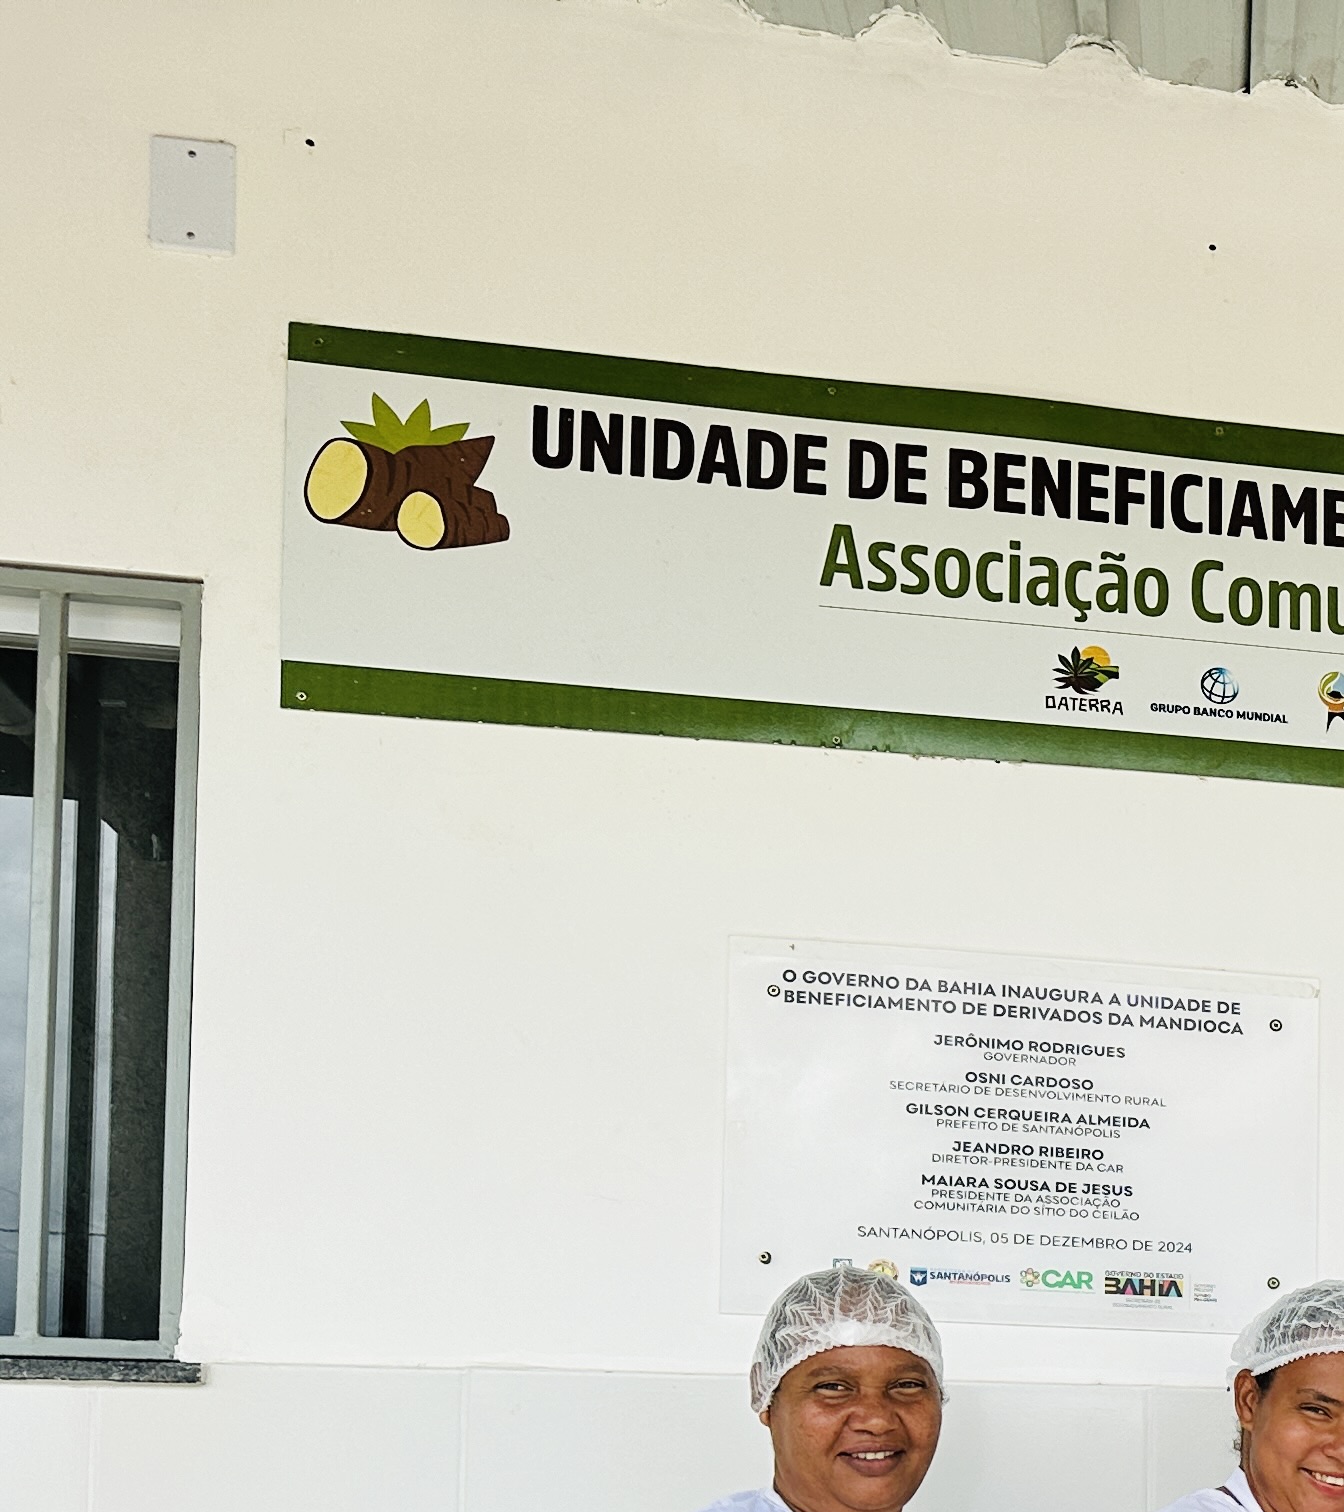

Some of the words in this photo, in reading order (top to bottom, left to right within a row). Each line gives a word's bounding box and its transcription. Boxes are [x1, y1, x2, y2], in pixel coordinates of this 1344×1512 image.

[532, 404, 827, 496] UNIDADE
[848, 438, 928, 505] DE
[819, 523, 1170, 623] Associação
[1150, 702, 1191, 716] GRUPO
[1193, 706, 1234, 720] BANCO
[1236, 711, 1289, 724] MUNDIAL
[782, 969, 797, 983] O
[802, 970, 900, 990] GOVERNO
[905, 977, 933, 993] DA
[938, 979, 997, 997] BAHIA
[1001, 984, 1104, 1005] INAUGURA
[1108, 993, 1122, 1007] A
[1126, 993, 1212, 1013] UNIDADE
[1217, 1001, 1241, 1015] DE
[784, 989, 957, 1014] BENEFICIAMENTO
[962, 1001, 988, 1016] DE
[993, 1004, 1103, 1025] DERIVADOS
[1108, 1012, 1135, 1028] DA
[1139, 1015, 1244, 1035] MANDIOCA
[933, 1032, 1024, 1052] JERÔNIMO
[1028, 1040, 1126, 1059] RODRIGUES
[983, 1051, 1077, 1067] GOVERNADOR
[964, 1071, 1006, 1085] OSNI
[1010, 1074, 1094, 1091] CARDOSO
[889, 1079, 971, 1095] SECRETÁRIO
[974, 1085, 991, 1096] DE
[995, 1086, 1122, 1105] DESENVOLVIMENTO
[1124, 1095, 1168, 1108] RURAL
[905, 1102, 969, 1117] GILSON
[973, 1106, 1073, 1125] CERQUEIRA
[1075, 1113, 1151, 1130] ALMEIDA
[936, 1118, 998, 1131] PREFEITO
[1001, 1122, 1019, 1133] DE
[1022, 1123, 1121, 1139] SANTANÓPOLIS
[951, 1140, 1034, 1157] JEANDRO
[1038, 1145, 1105, 1161] RIBEIRO
[931, 1153, 1073, 1171] DIRETOR-PRESIDENTE
[1075, 1161, 1094, 1172] DA
[1096, 1162, 1124, 1174] CAR
[921, 1174, 990, 1190] MAIARA
[993, 1177, 1051, 1193] SOUSA
[1055, 1181, 1078, 1194] DE
[1081, 1182, 1134, 1198] JESUS
[931, 1188, 1010, 1203] PRESIDENTE
[1014, 1193, 1033, 1204] DA
[1035, 1194, 1121, 1210] ASSOCIAÇÃO
[913, 1200, 1007, 1215] COMUNITÁRIA
[1010, 1205, 1031, 1215] DO
[1033, 1204, 1066, 1218] SÍTIO
[1069, 1208, 1089, 1219] DO
[1091, 1208, 1140, 1222] CEILÃO
[857, 1225, 986, 1245] SANTANÓPOLIS,
[990, 1232, 1009, 1245] 05
[1013, 1233, 1035, 1246] DE
[1040, 1234, 1128, 1251] DEZEMBRO
[1132, 1239, 1153, 1253] DE
[1157, 1241, 1193, 1254] 2024
[1041, 1269, 1094, 1290] CAR
[1104, 1276, 1183, 1298] BAHIA
